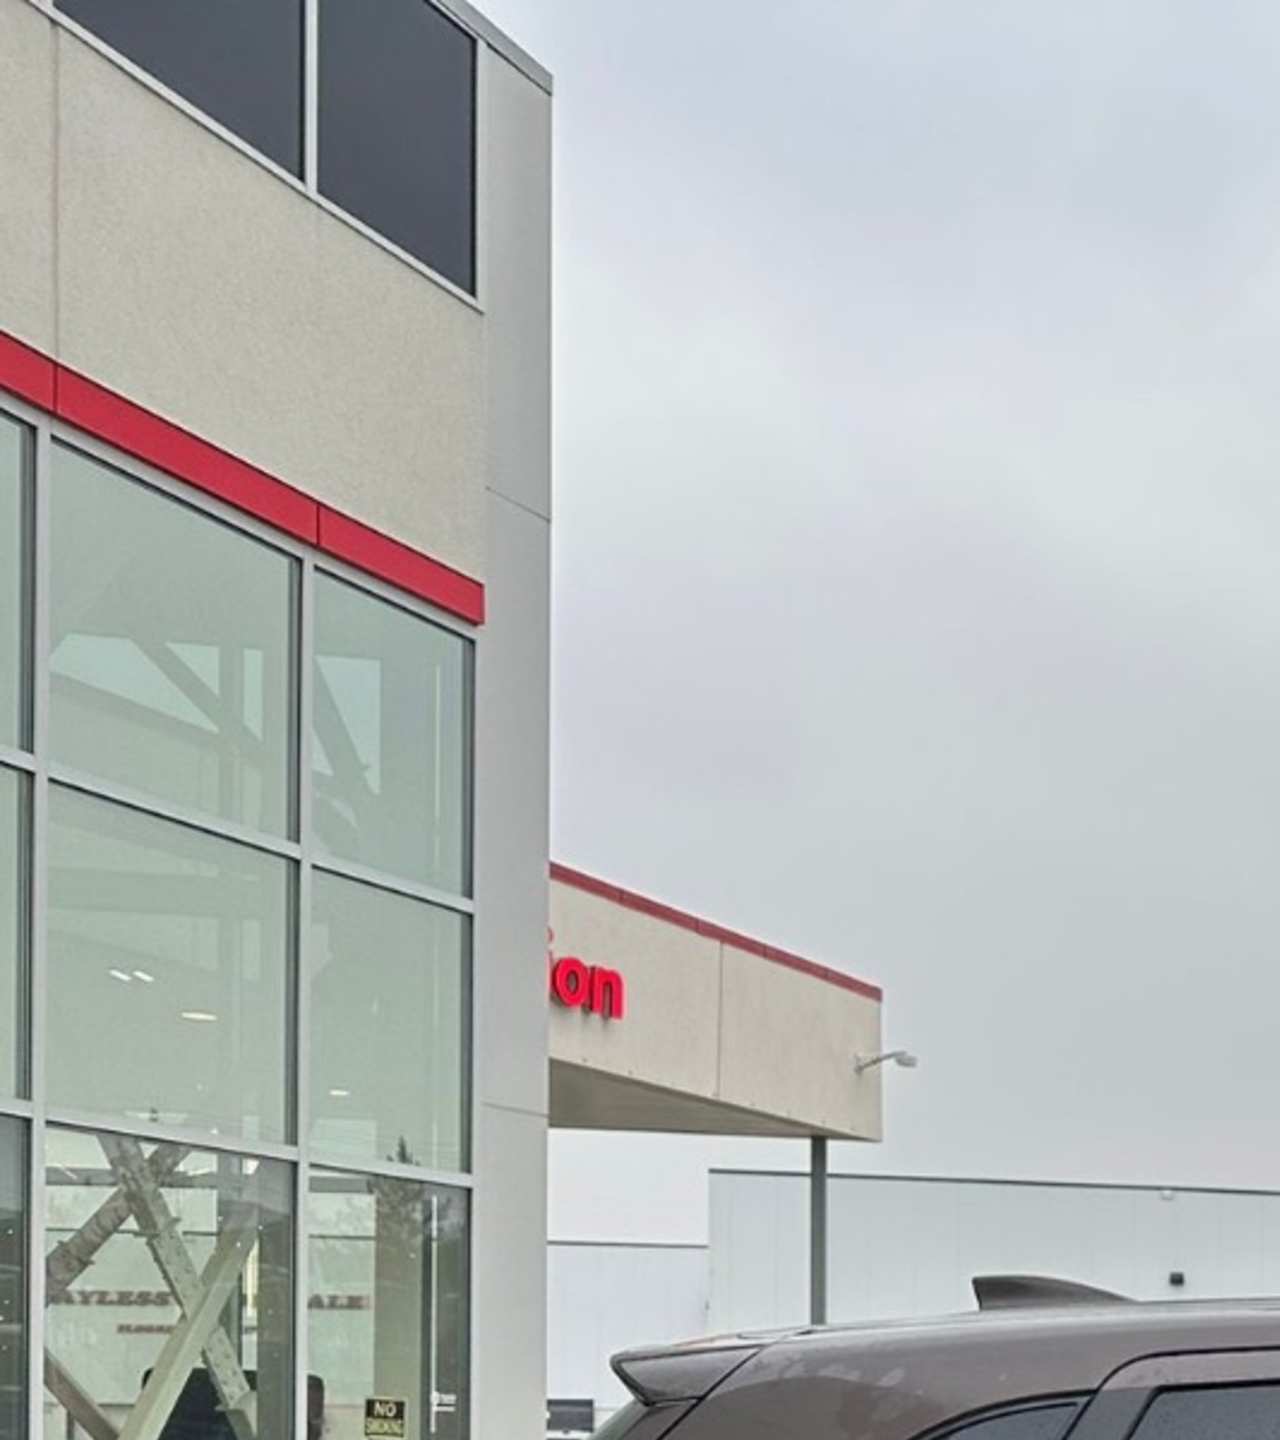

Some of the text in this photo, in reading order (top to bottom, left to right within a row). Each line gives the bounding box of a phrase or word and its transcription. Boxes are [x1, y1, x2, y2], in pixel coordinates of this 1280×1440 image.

[547, 928, 624, 1020] on
[50, 1290, 171, 1306] AYLESS
[374, 1401, 397, 1417] NO
